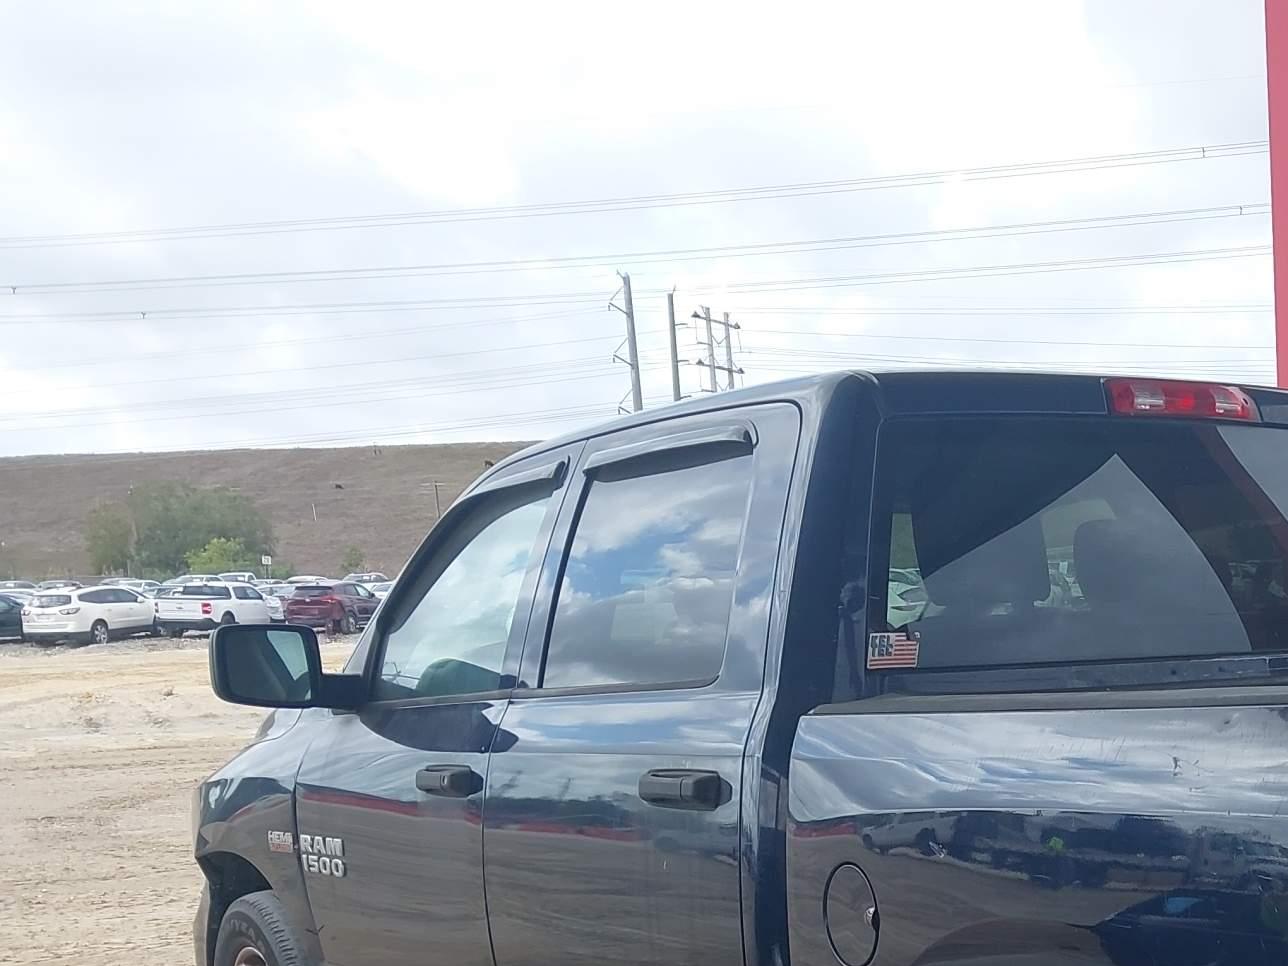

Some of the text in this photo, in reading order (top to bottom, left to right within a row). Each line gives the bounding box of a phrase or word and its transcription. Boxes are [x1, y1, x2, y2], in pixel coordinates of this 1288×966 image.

[268, 830, 293, 845] HEMI
[300, 834, 343, 856] RAM
[302, 854, 345, 878] 1500
